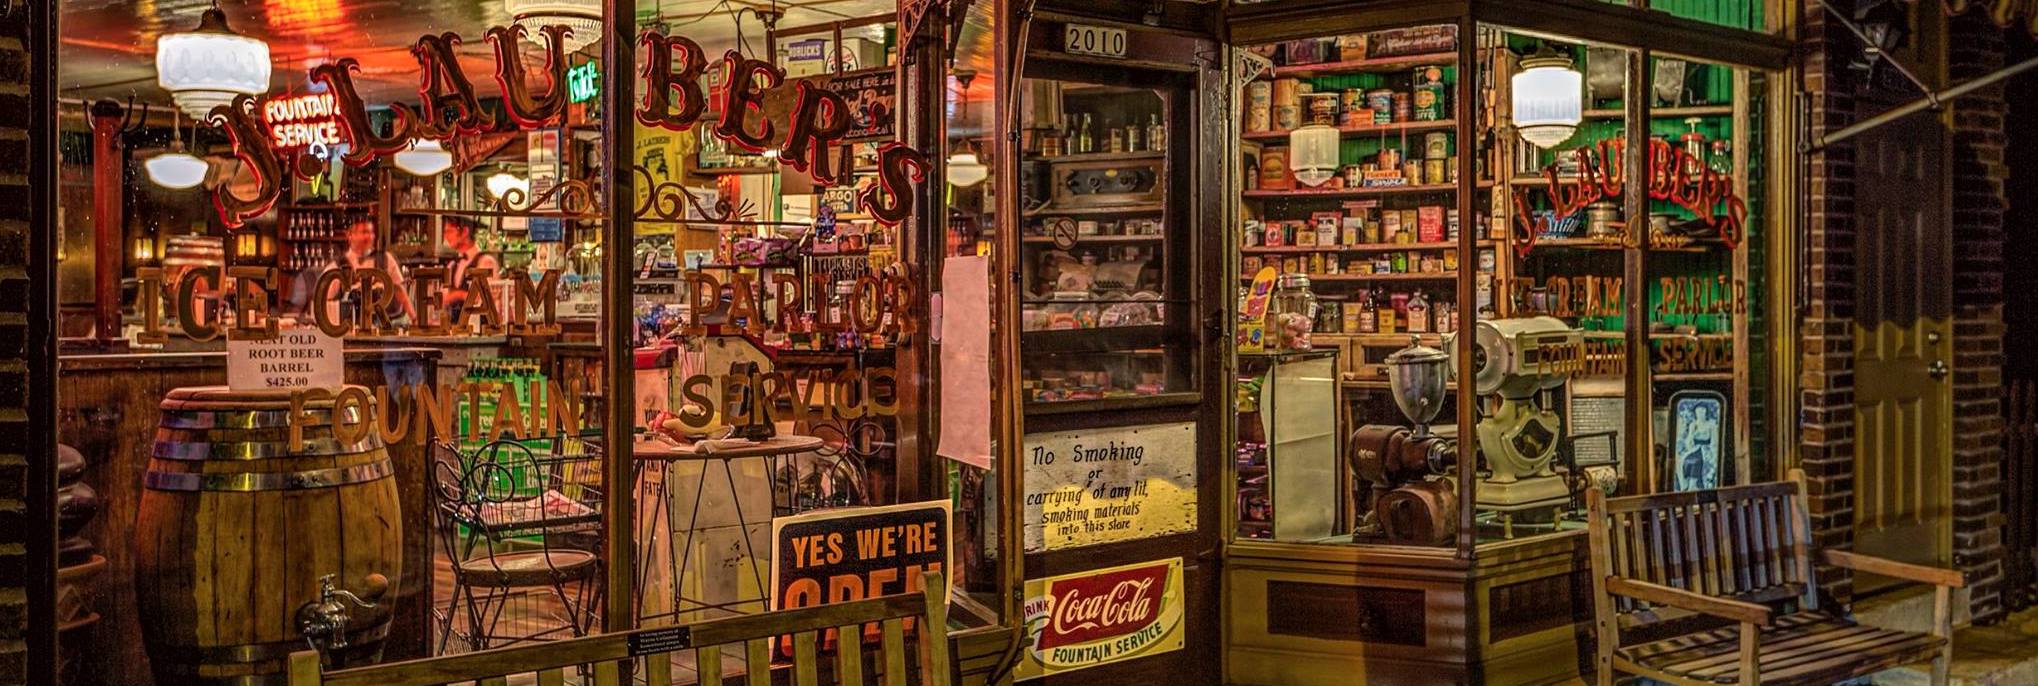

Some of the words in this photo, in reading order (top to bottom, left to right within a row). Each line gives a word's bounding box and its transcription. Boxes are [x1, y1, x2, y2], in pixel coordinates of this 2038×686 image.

[1070, 28, 1125, 54] 2010
[273, 121, 341, 148] SERVICE
[822, 190, 854, 203] ARGO
[136, 266, 280, 344] ICE
[313, 267, 563, 338] CREAM
[685, 271, 919, 336] PARLOR
[1545, 274, 1623, 317] CREAM
[1660, 275, 1747, 316] PARLOR
[288, 335, 317, 345] OLD
[248, 348, 287, 360] ROOT
[289, 348, 325, 359] BEER
[1658, 335, 1734, 371] SERVICE
[259, 361, 315, 373] BARREL
[265, 376, 309, 387] $425.00
[288, 380, 583, 453] FOUNTAIN
[679, 366, 901, 429] SERVICE
[1032, 446, 1055, 466] No
[1073, 441, 1145, 466] Smoking
[1088, 469, 1104, 479] or
[1026, 488, 1085, 507] carrying
[1092, 483, 1106, 500] of
[1110, 486, 1132, 502] any
[1041, 507, 1090, 524] smoking
[1094, 501, 1141, 519] materials
[1057, 521, 1080, 536] into
[1084, 519, 1105, 534] this
[1108, 518, 1131, 531] store
[791, 532, 845, 568] YES
[855, 521, 938, 560] WE'RE
[1023, 599, 1051, 617] RINK
[1052, 645, 1112, 663] FOUNTAIN
[1115, 622, 1163, 654] SERVICE
